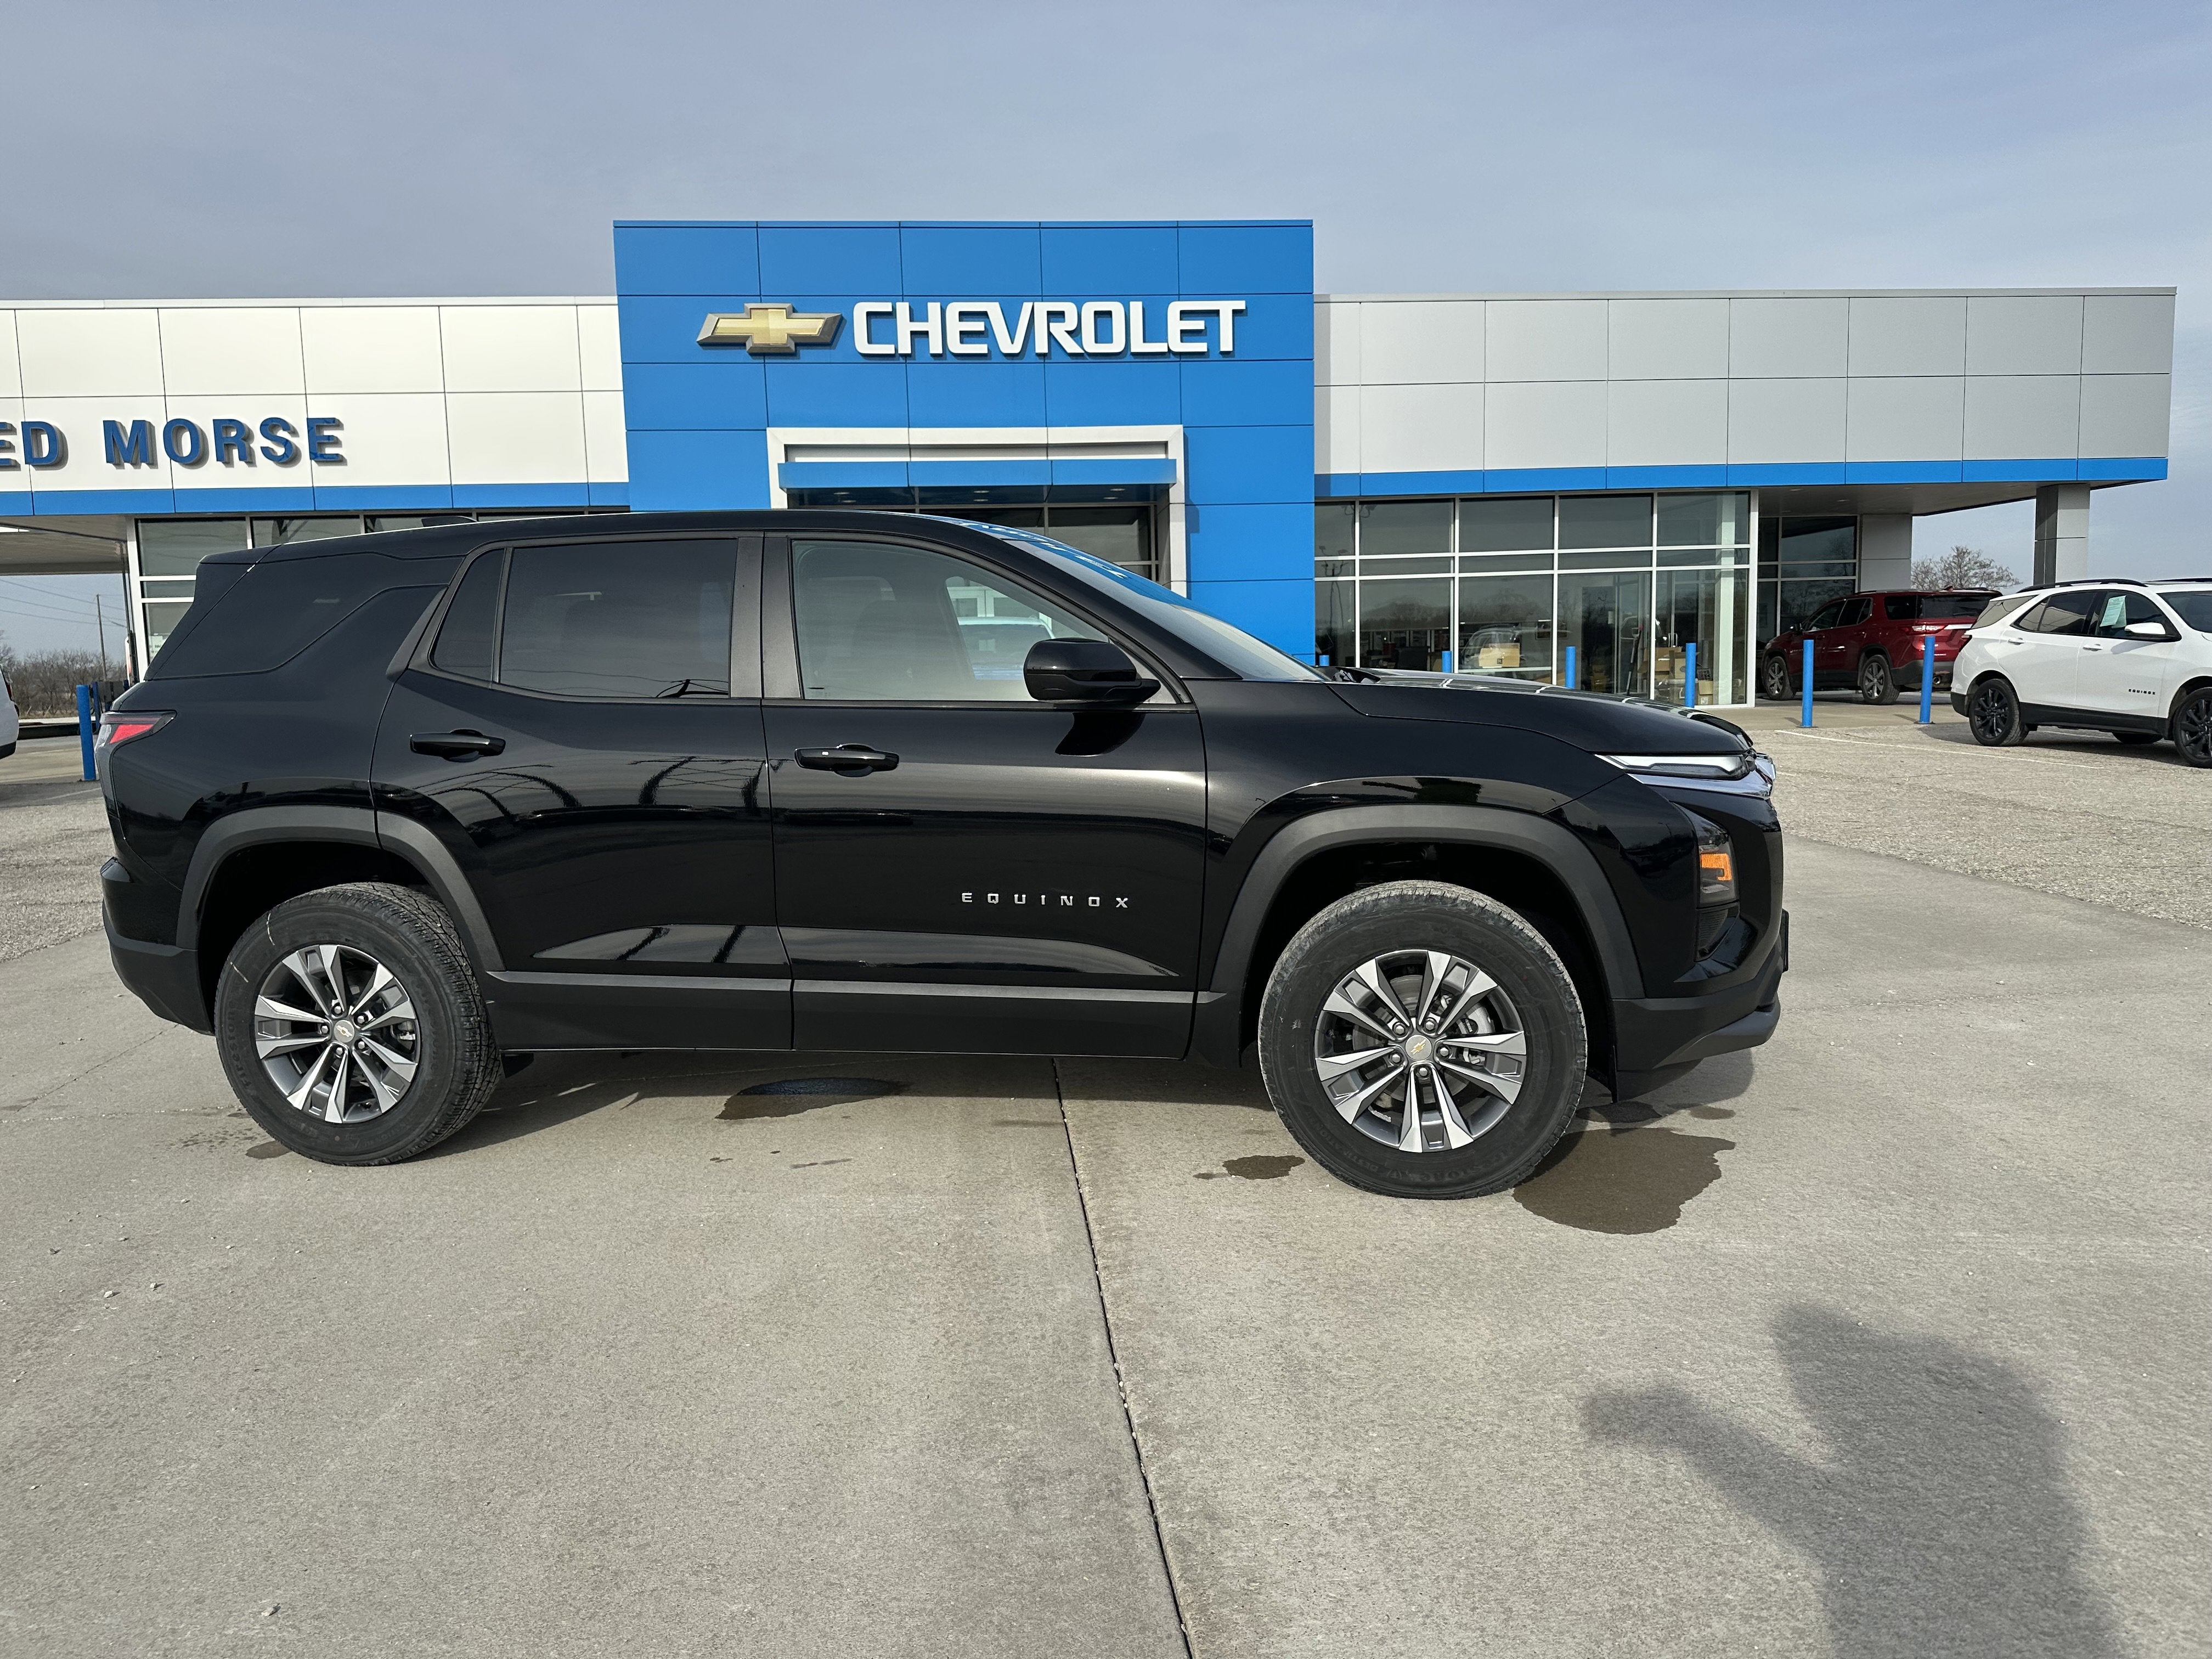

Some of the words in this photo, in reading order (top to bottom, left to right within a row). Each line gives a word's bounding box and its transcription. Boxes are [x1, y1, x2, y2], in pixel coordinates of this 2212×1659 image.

[852, 299, 1246, 356] CHEVROLET
[103, 416, 346, 465] MORSE
[961, 892, 1128, 909] EQUINOX
